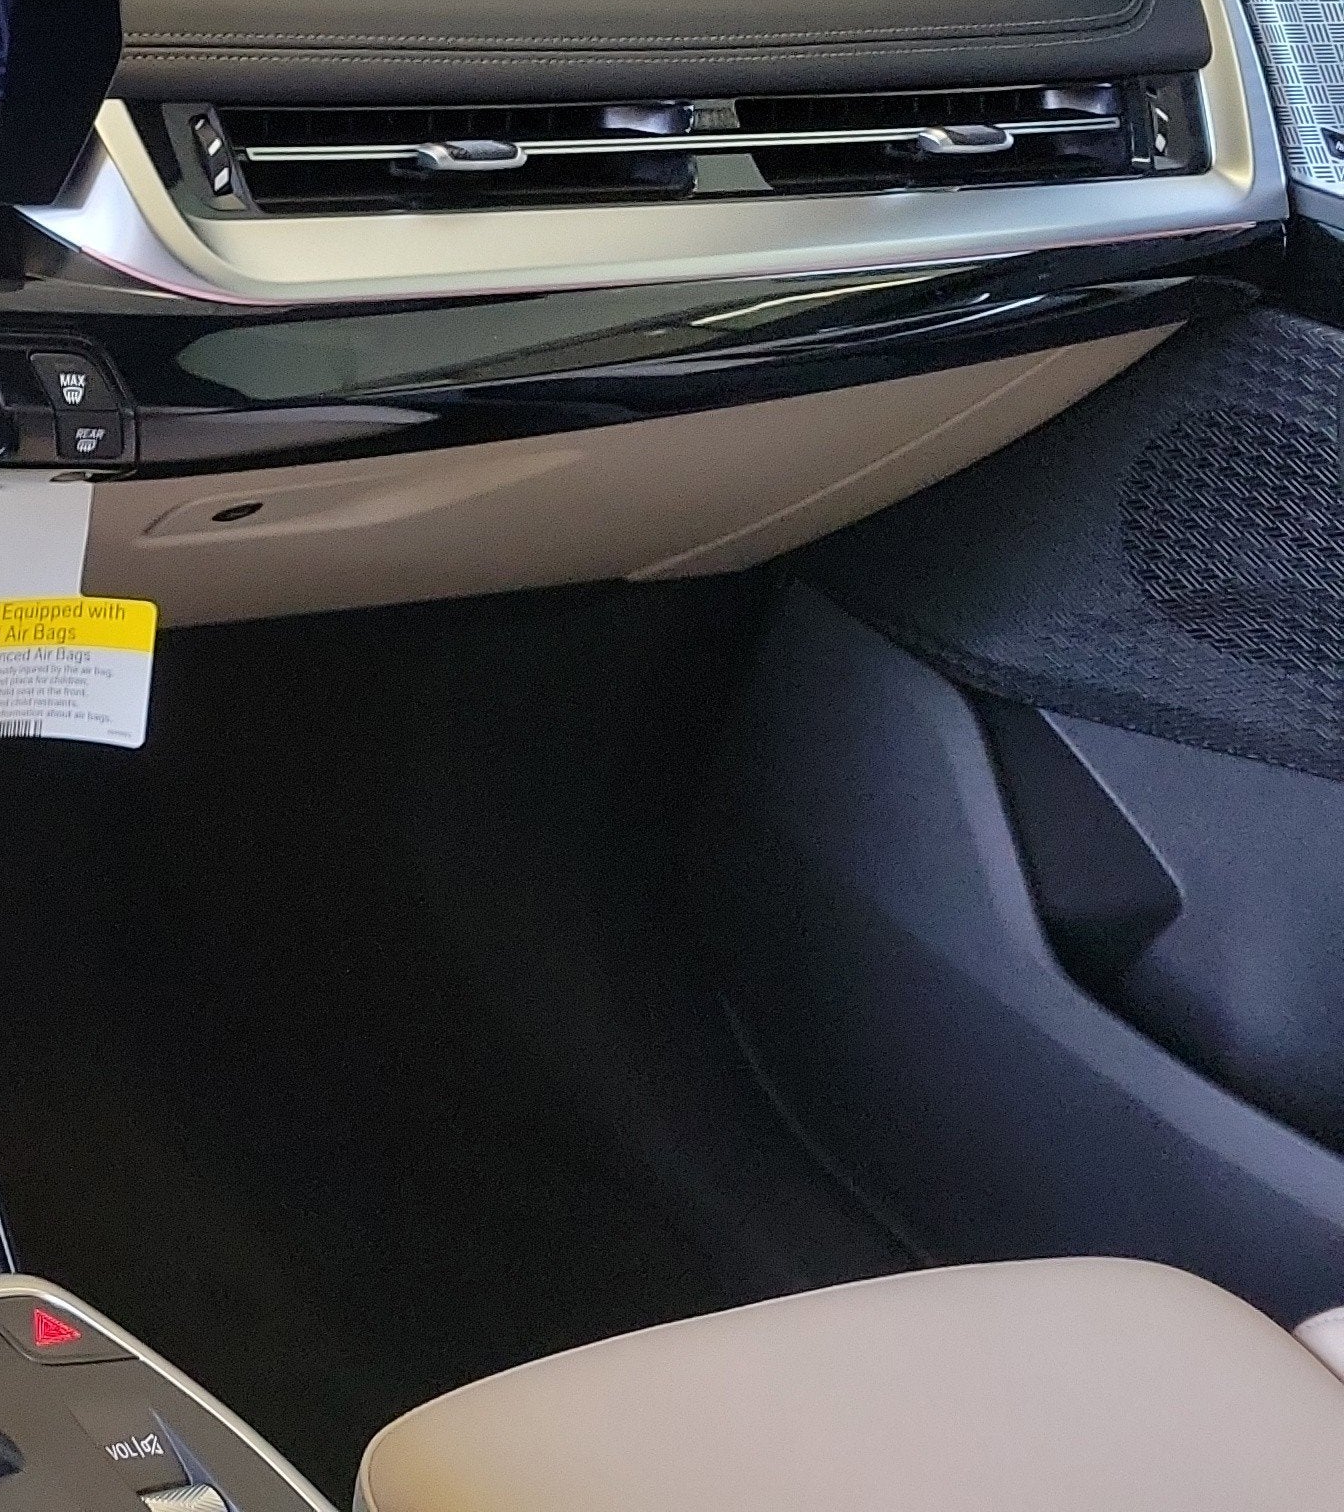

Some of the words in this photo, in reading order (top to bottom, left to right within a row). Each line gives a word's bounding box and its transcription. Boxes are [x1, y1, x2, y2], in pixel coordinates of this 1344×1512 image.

[59, 373, 86, 387] MAX
[75, 427, 106, 440] REAR
[2, 600, 83, 626] Equipped
[88, 601, 126, 620] with
[5, 624, 30, 643] Air
[33, 622, 77, 644] Bags
[34, 647, 53, 661] Air
